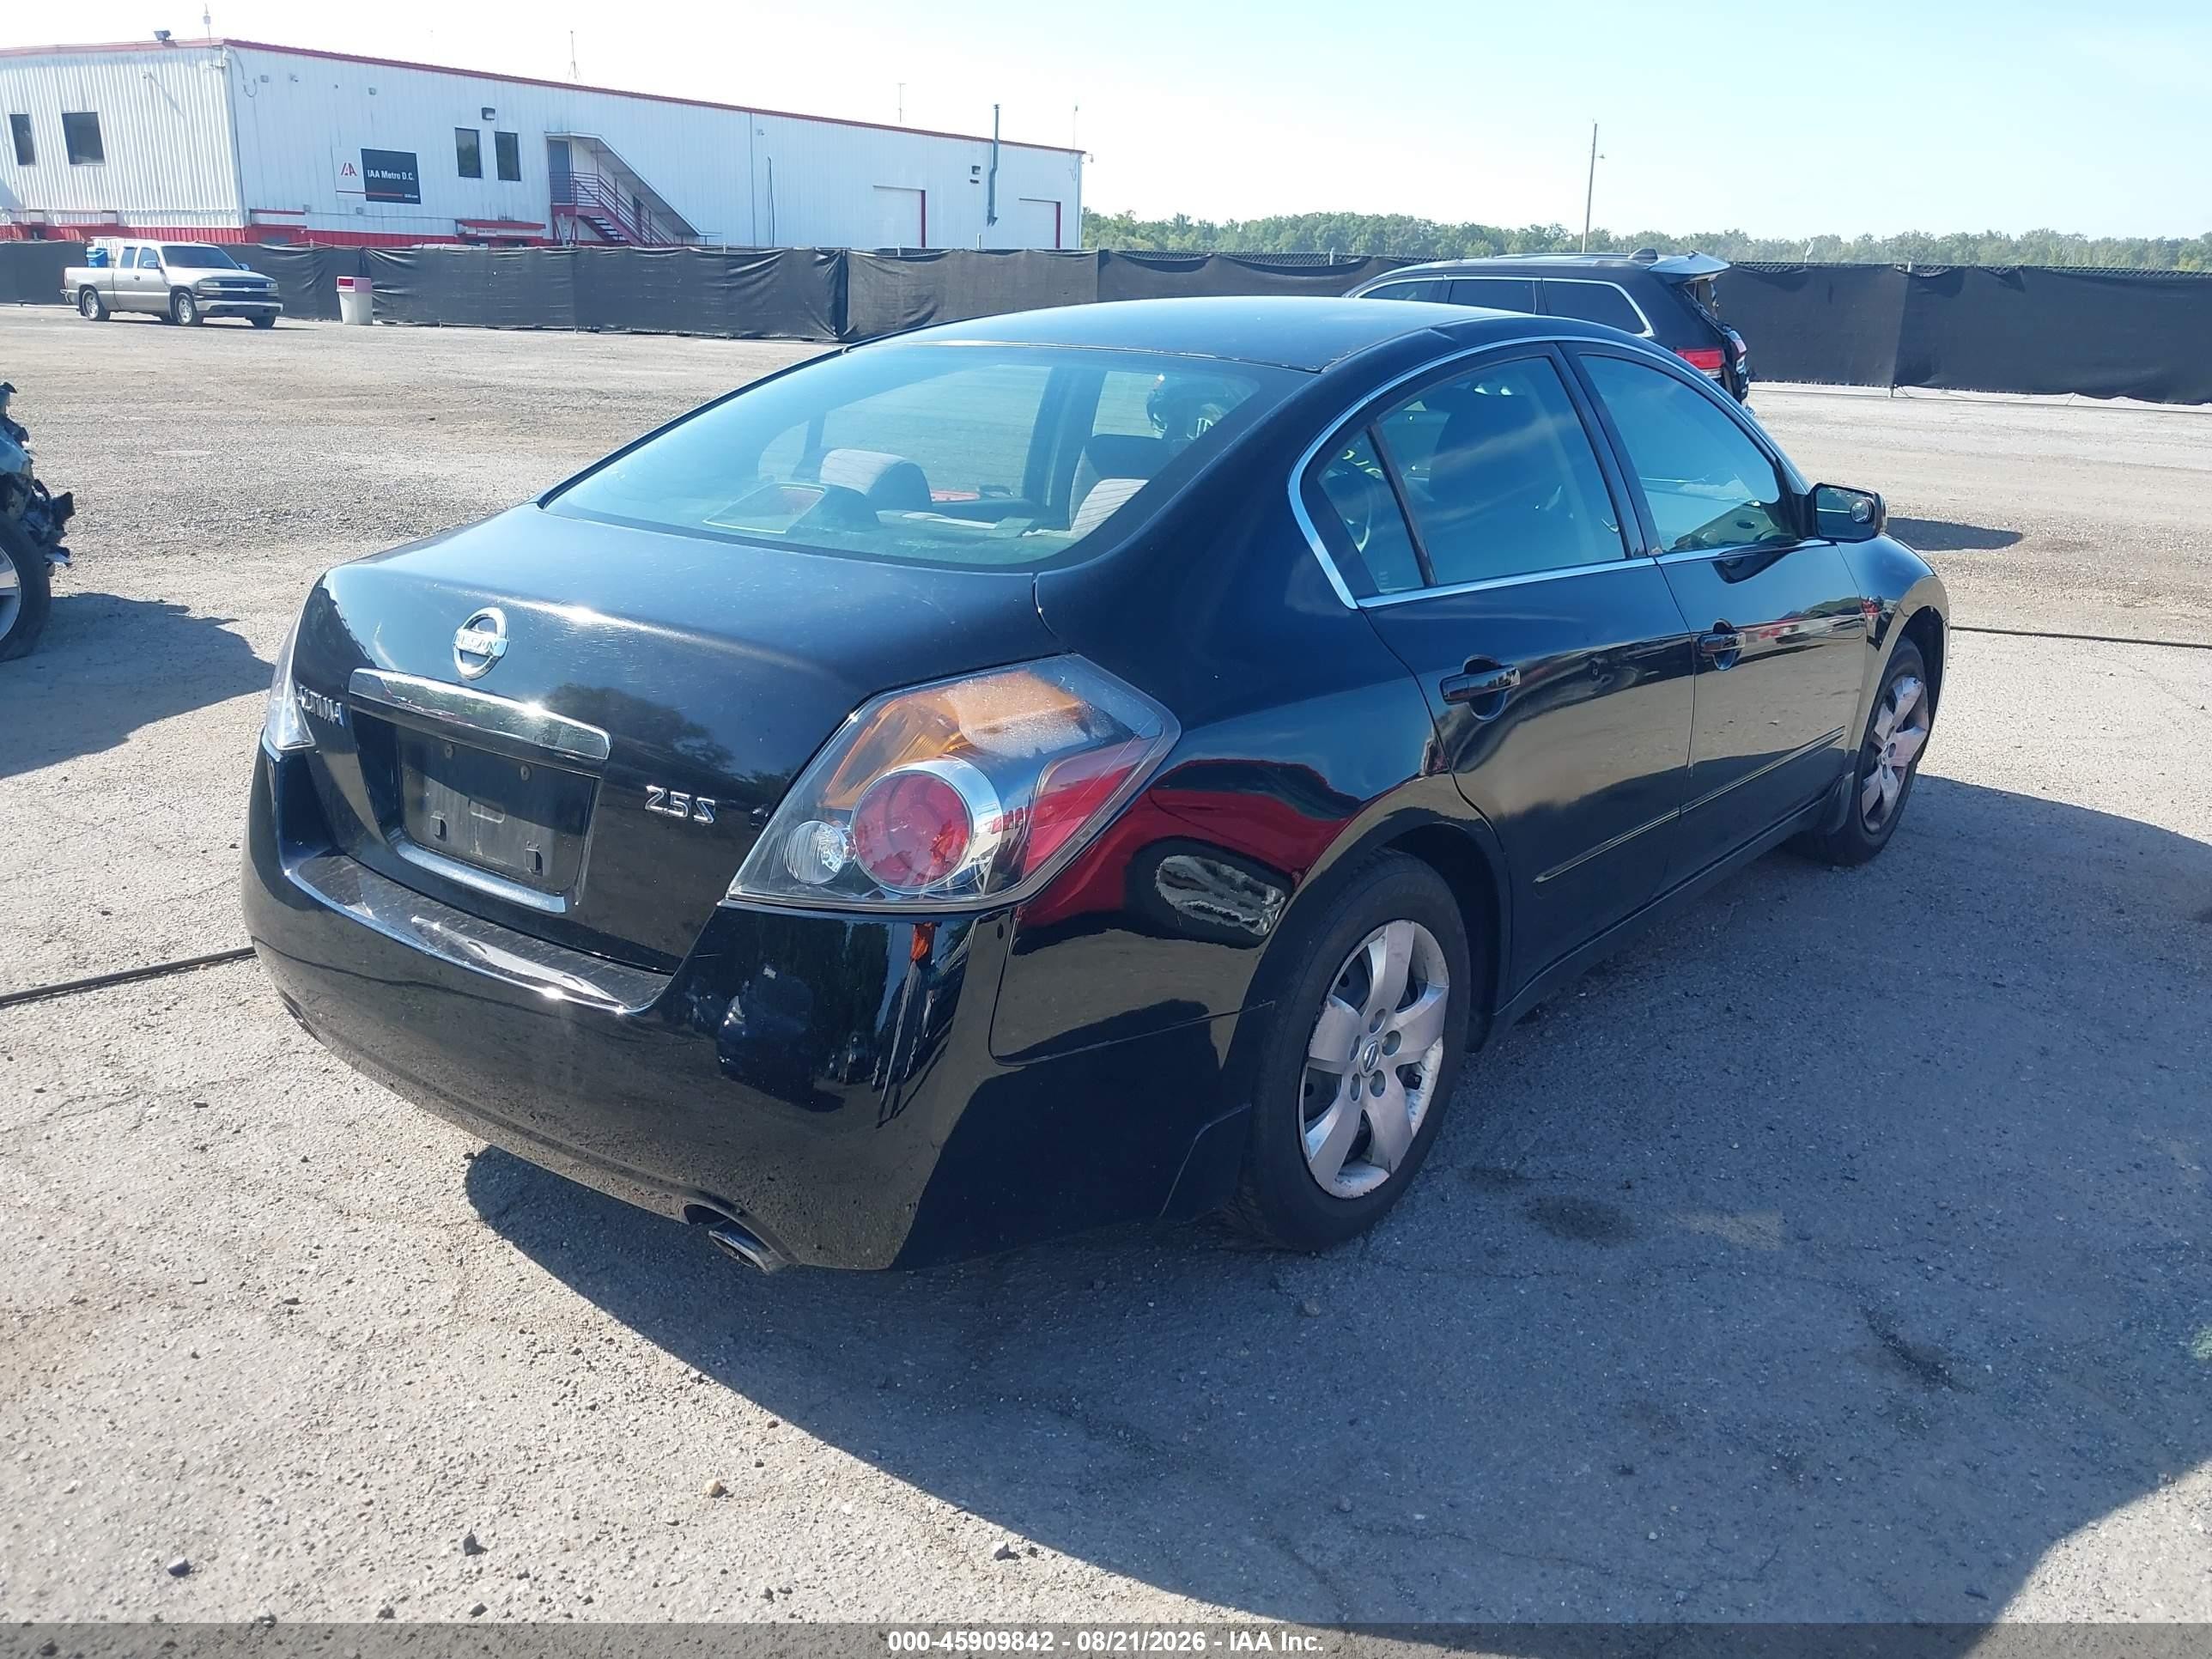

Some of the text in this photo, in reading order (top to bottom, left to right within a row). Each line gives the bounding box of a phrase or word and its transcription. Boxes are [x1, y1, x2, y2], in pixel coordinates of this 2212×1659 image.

[367, 169, 416, 181] IAA Metro D.C.
